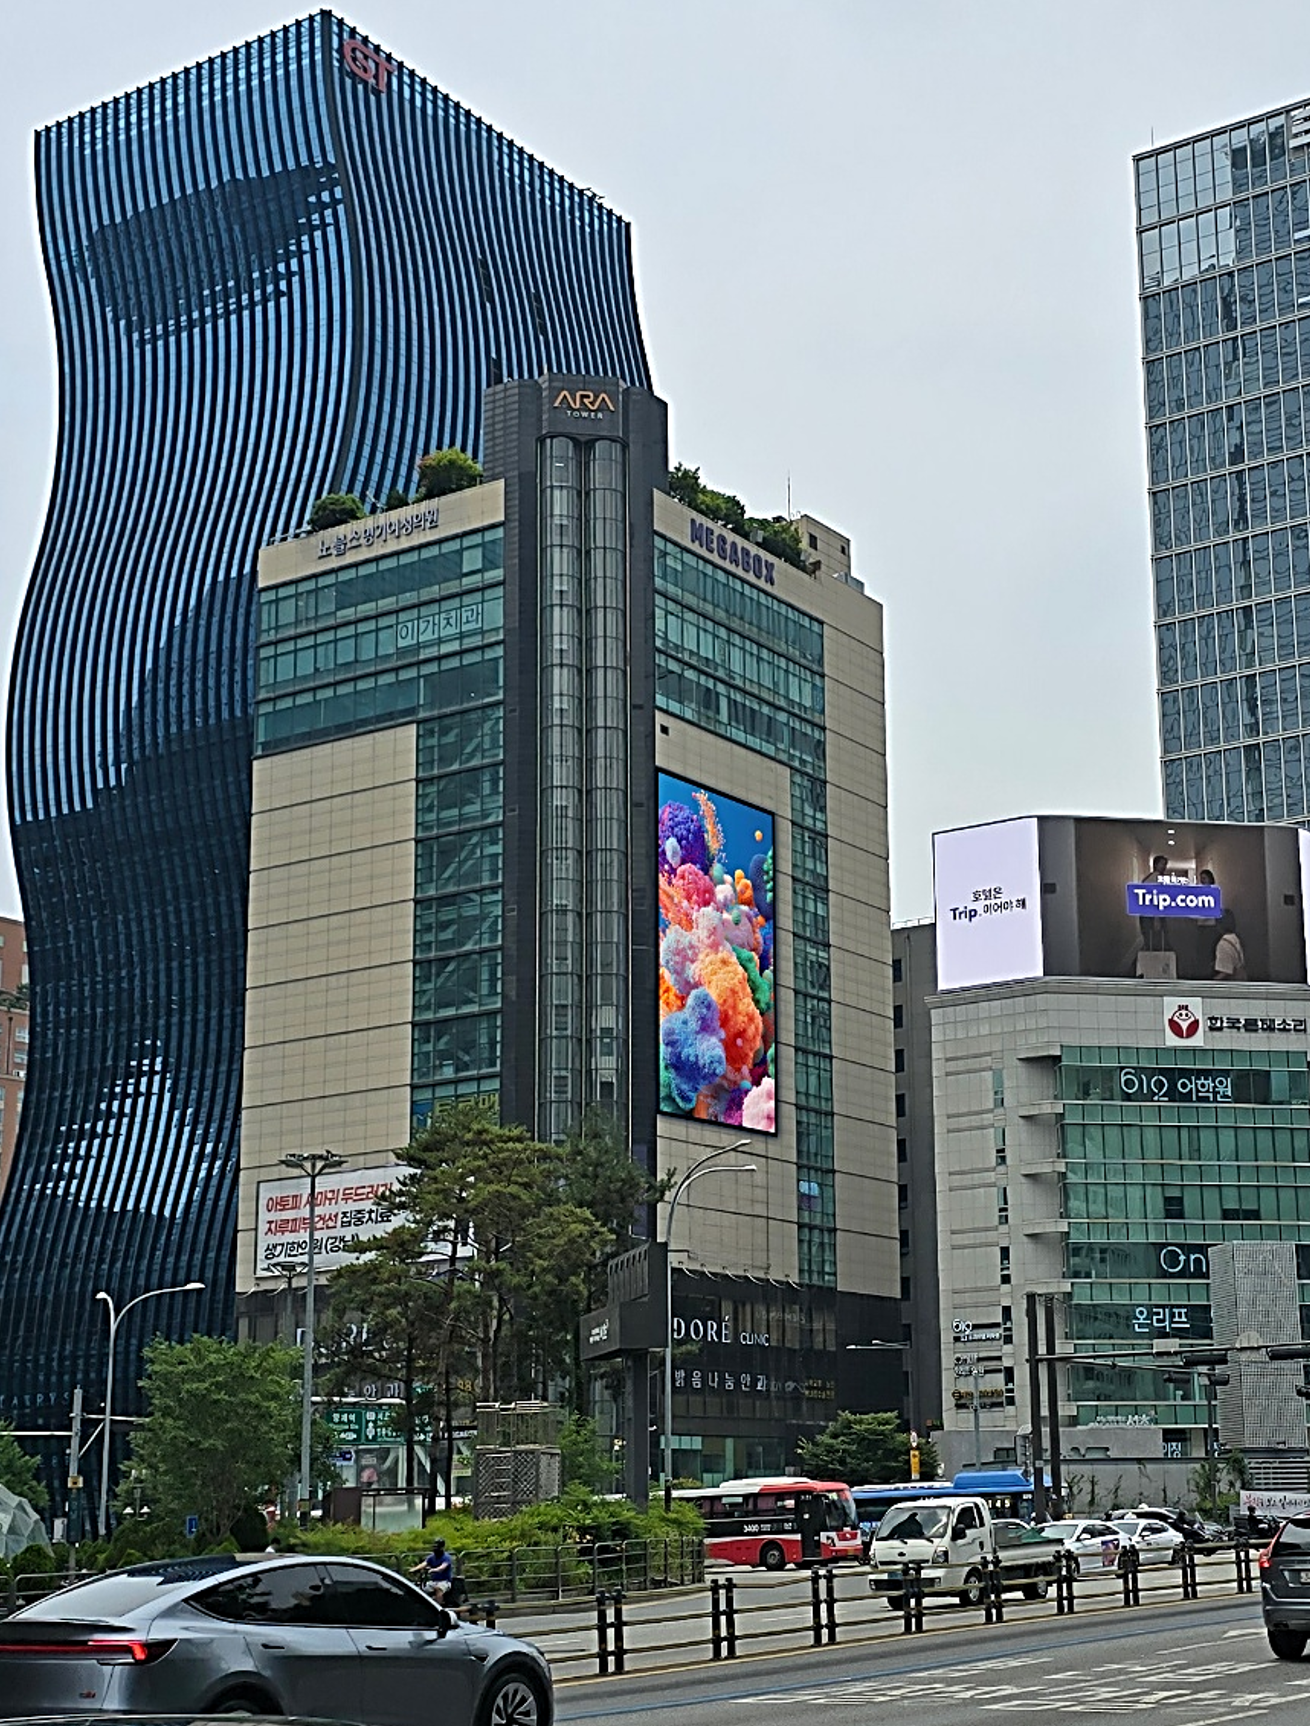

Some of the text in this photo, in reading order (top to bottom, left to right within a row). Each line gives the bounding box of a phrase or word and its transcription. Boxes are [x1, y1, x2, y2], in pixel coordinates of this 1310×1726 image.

[343, 38, 397, 92] GT
[553, 390, 615, 412] ARA
[566, 410, 603, 419] TOWER
[690, 518, 775, 587] MEGABOX
[399, 604, 482, 641] 이가치과
[1133, 889, 1215, 910] Trip.com
[1120, 1068, 1232, 1101] 612 어학원
[266, 1193, 303, 1213] 아토피
[673, 1315, 731, 1343] DORÉ
[1132, 1307, 1191, 1332] 온리프
[674, 1368, 768, 1392] 밝음나눔안과
